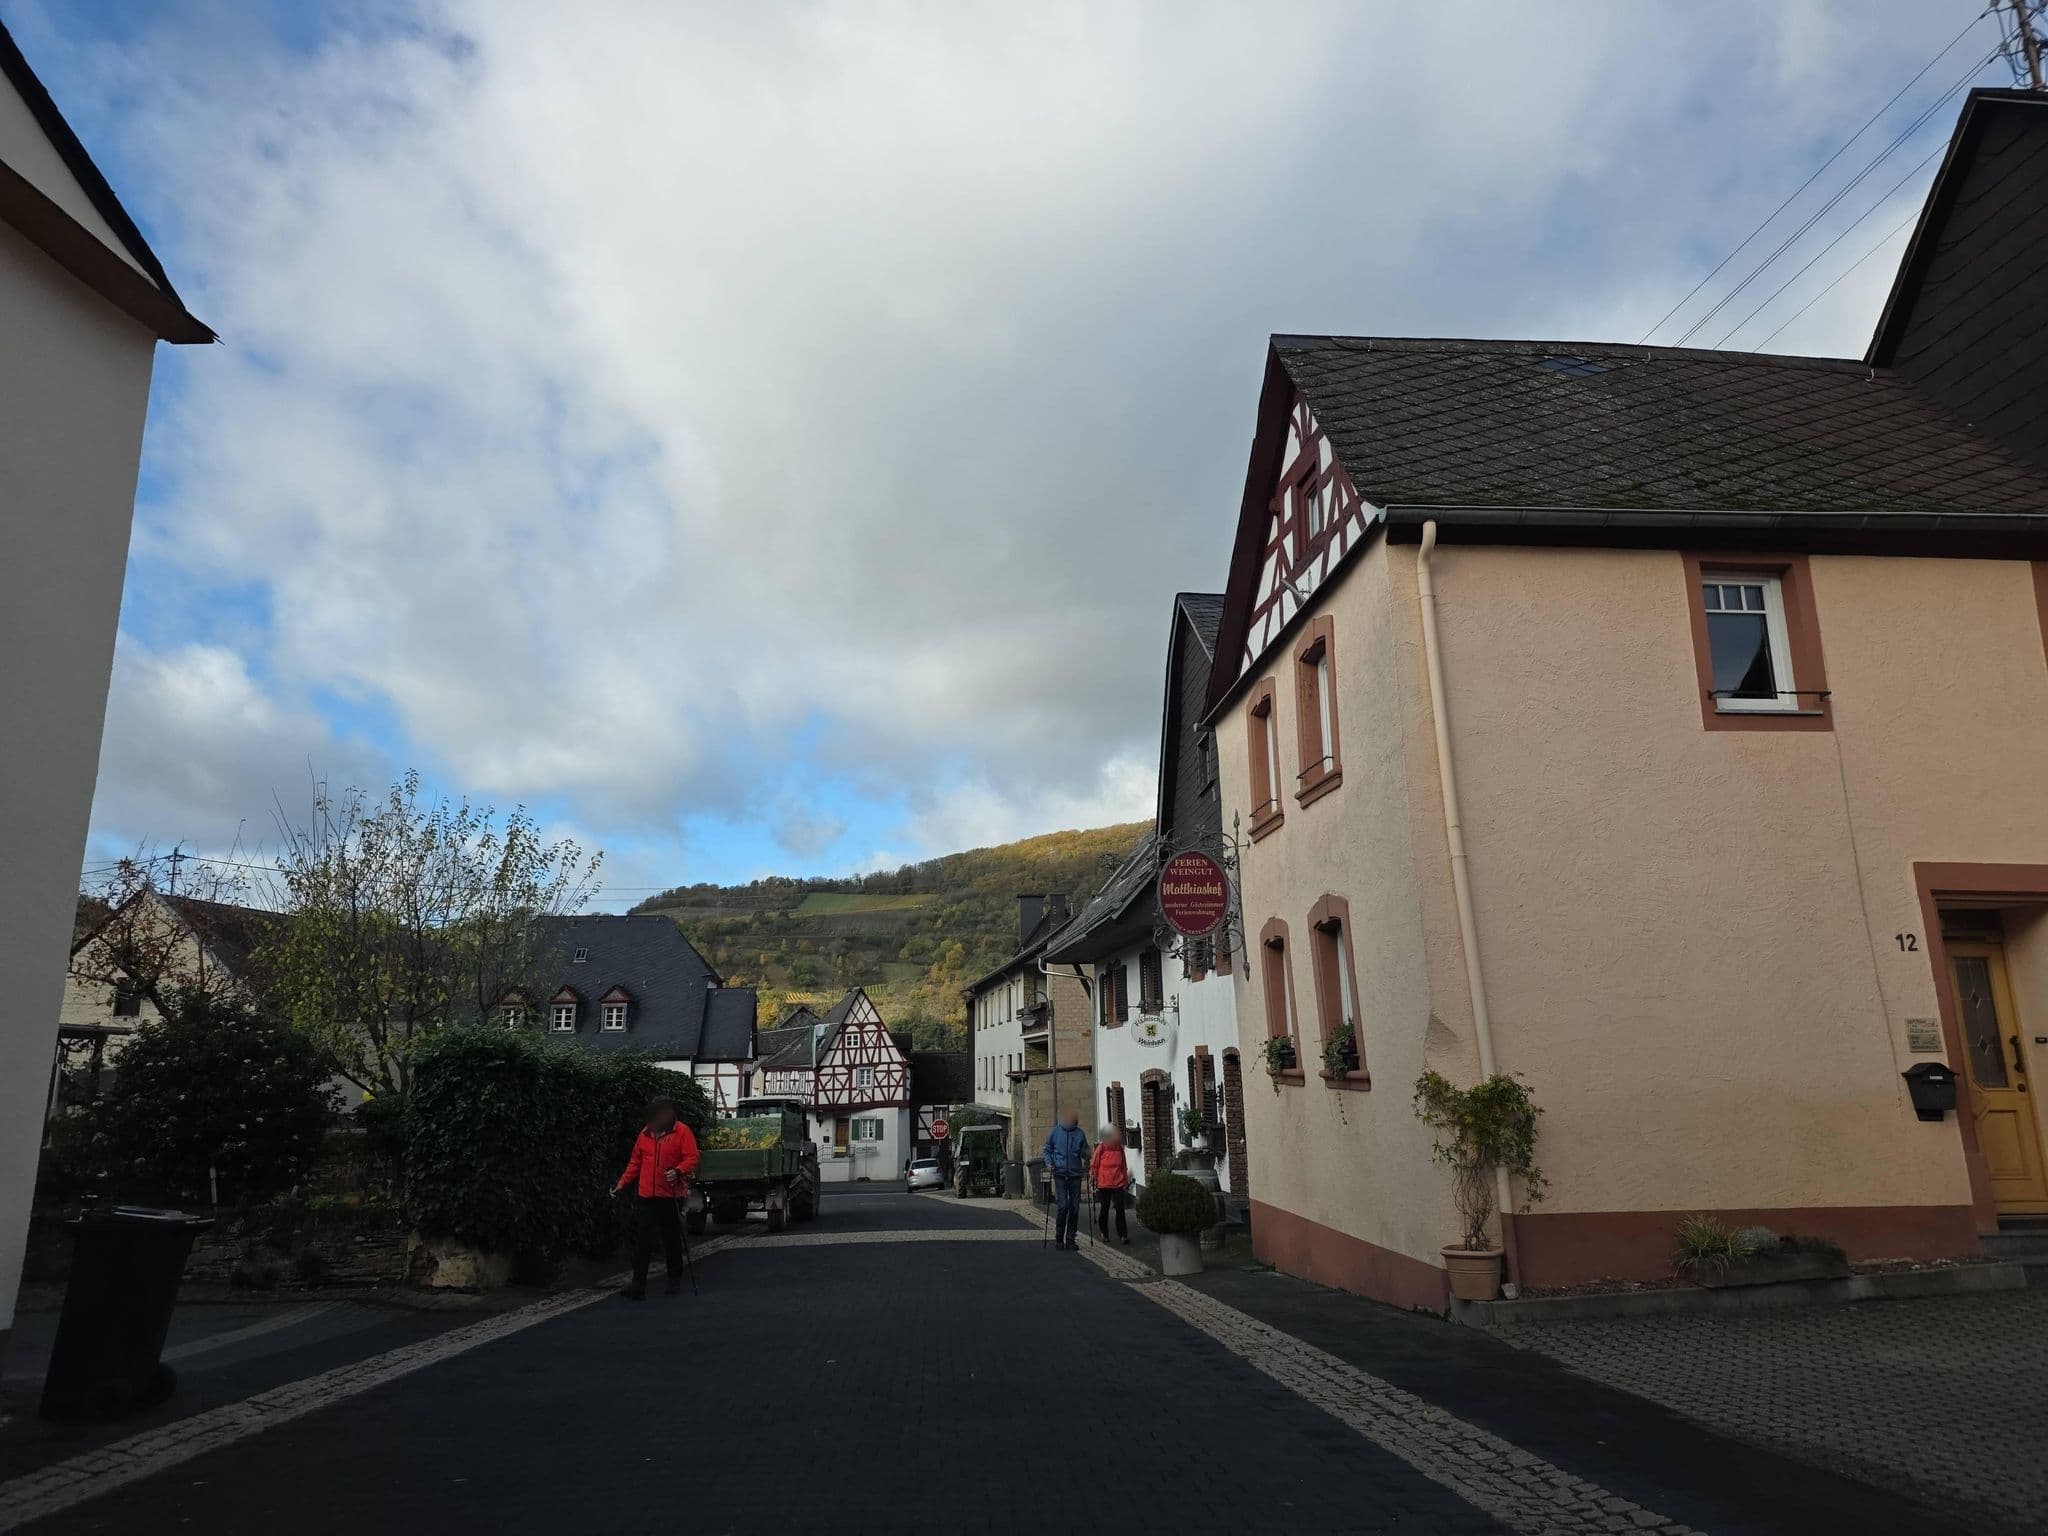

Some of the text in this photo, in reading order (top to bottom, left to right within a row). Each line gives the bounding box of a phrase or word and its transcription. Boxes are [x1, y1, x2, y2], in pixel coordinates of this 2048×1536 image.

[1174, 859, 1208, 867] FERIEN
[1169, 868, 1214, 876] WEINGUT
[1162, 882, 1222, 896] Matthiashof
[1895, 933, 1918, 951] 12
[932, 1125, 947, 1133] STOP
